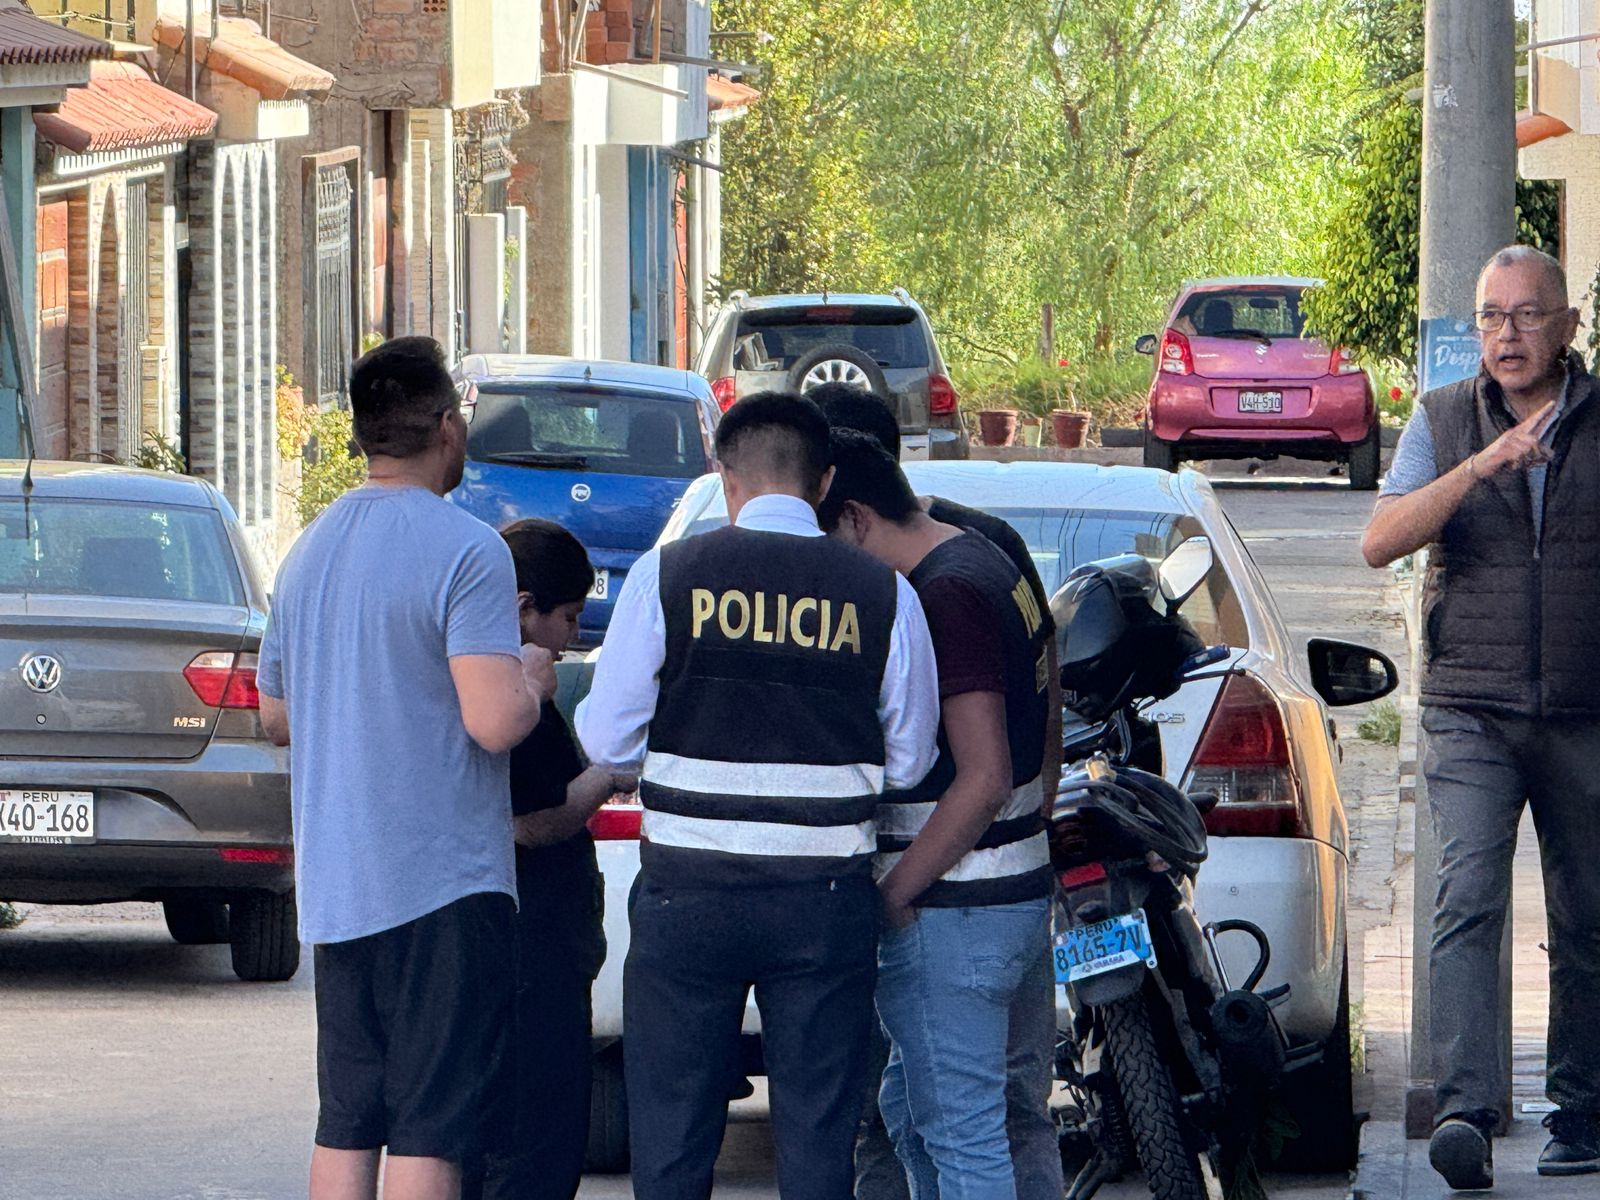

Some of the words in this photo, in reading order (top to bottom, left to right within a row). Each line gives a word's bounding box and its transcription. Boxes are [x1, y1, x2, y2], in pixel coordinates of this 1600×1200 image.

[692, 588, 861, 654] POLICIA
[173, 717, 206, 728] MSI
[22, 792, 60, 802] PERU
[1075, 918, 1114, 940] PERU
[1056, 925, 1143, 972] 8165-7V
